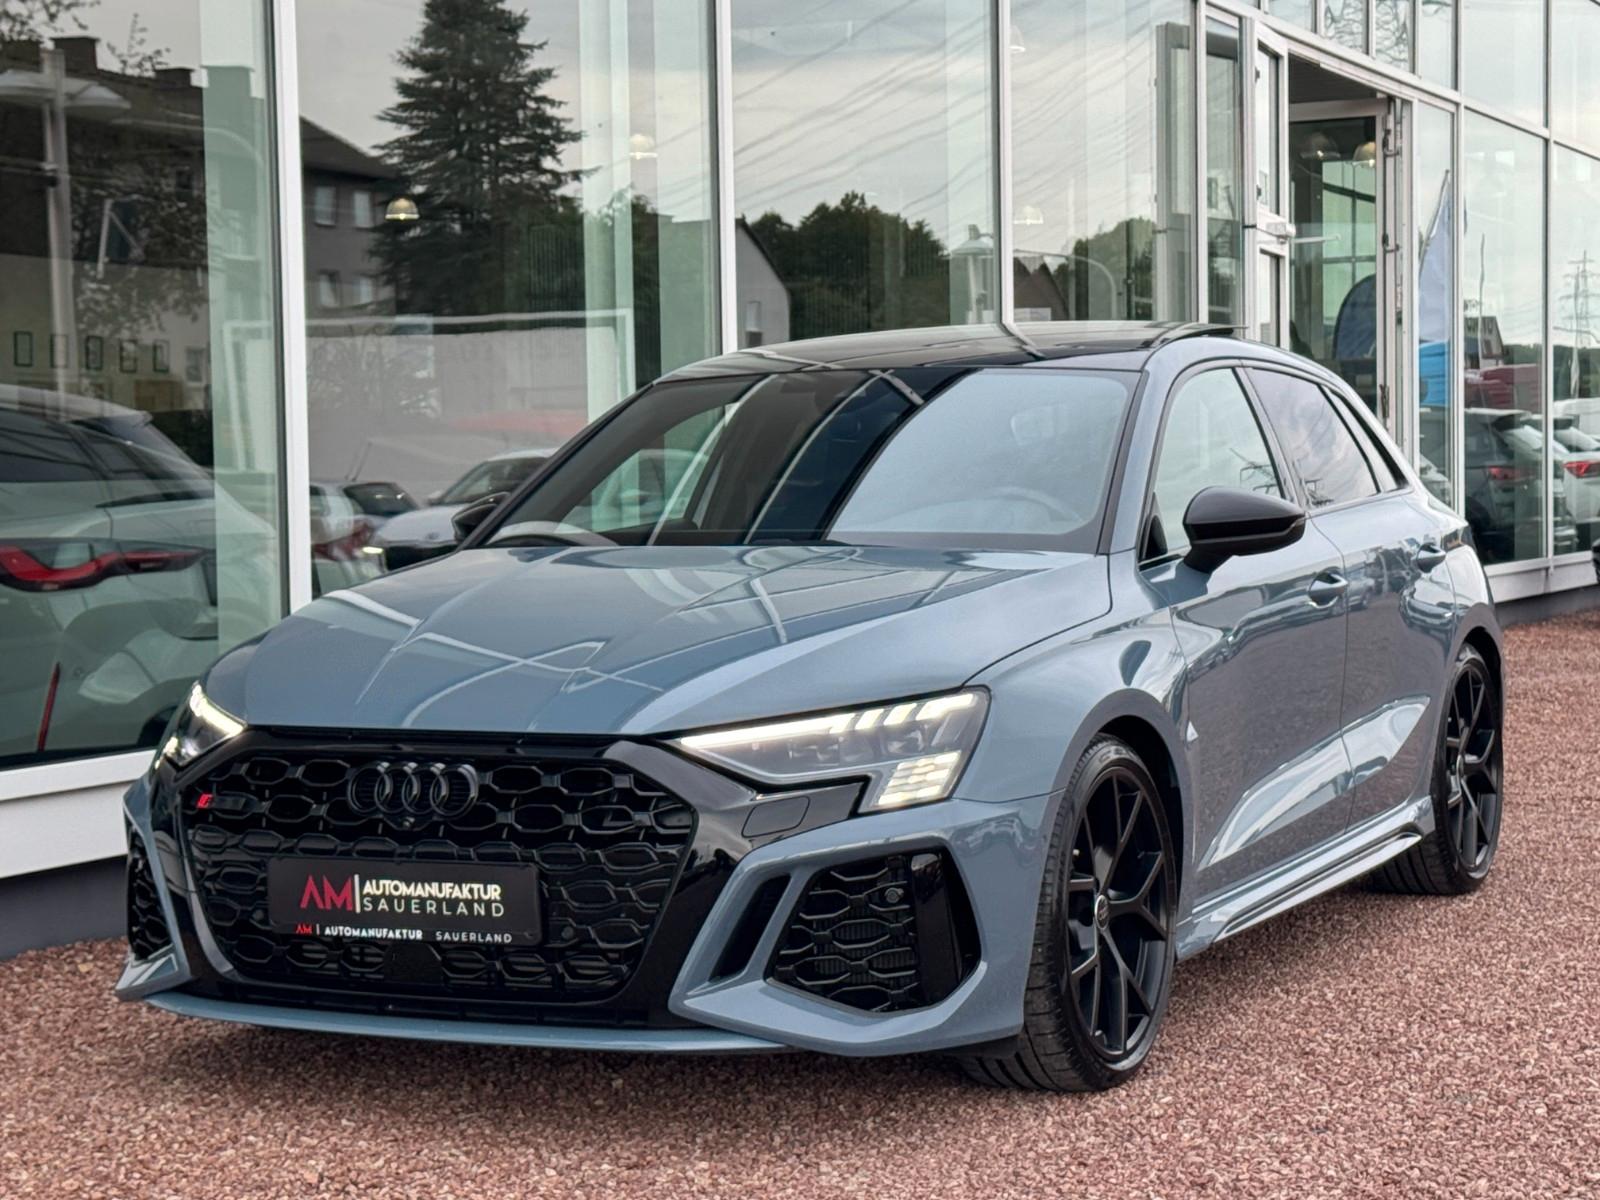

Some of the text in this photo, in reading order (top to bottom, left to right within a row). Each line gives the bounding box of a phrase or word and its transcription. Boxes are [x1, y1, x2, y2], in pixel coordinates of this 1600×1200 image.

[300, 874, 353, 911] AM
[362, 879, 502, 901] AUTOMANUFAKTUR
[363, 897, 505, 917] SAUERLAND
[295, 924, 513, 943] AM AUTOMANUFAKTUR SAUERLAND
